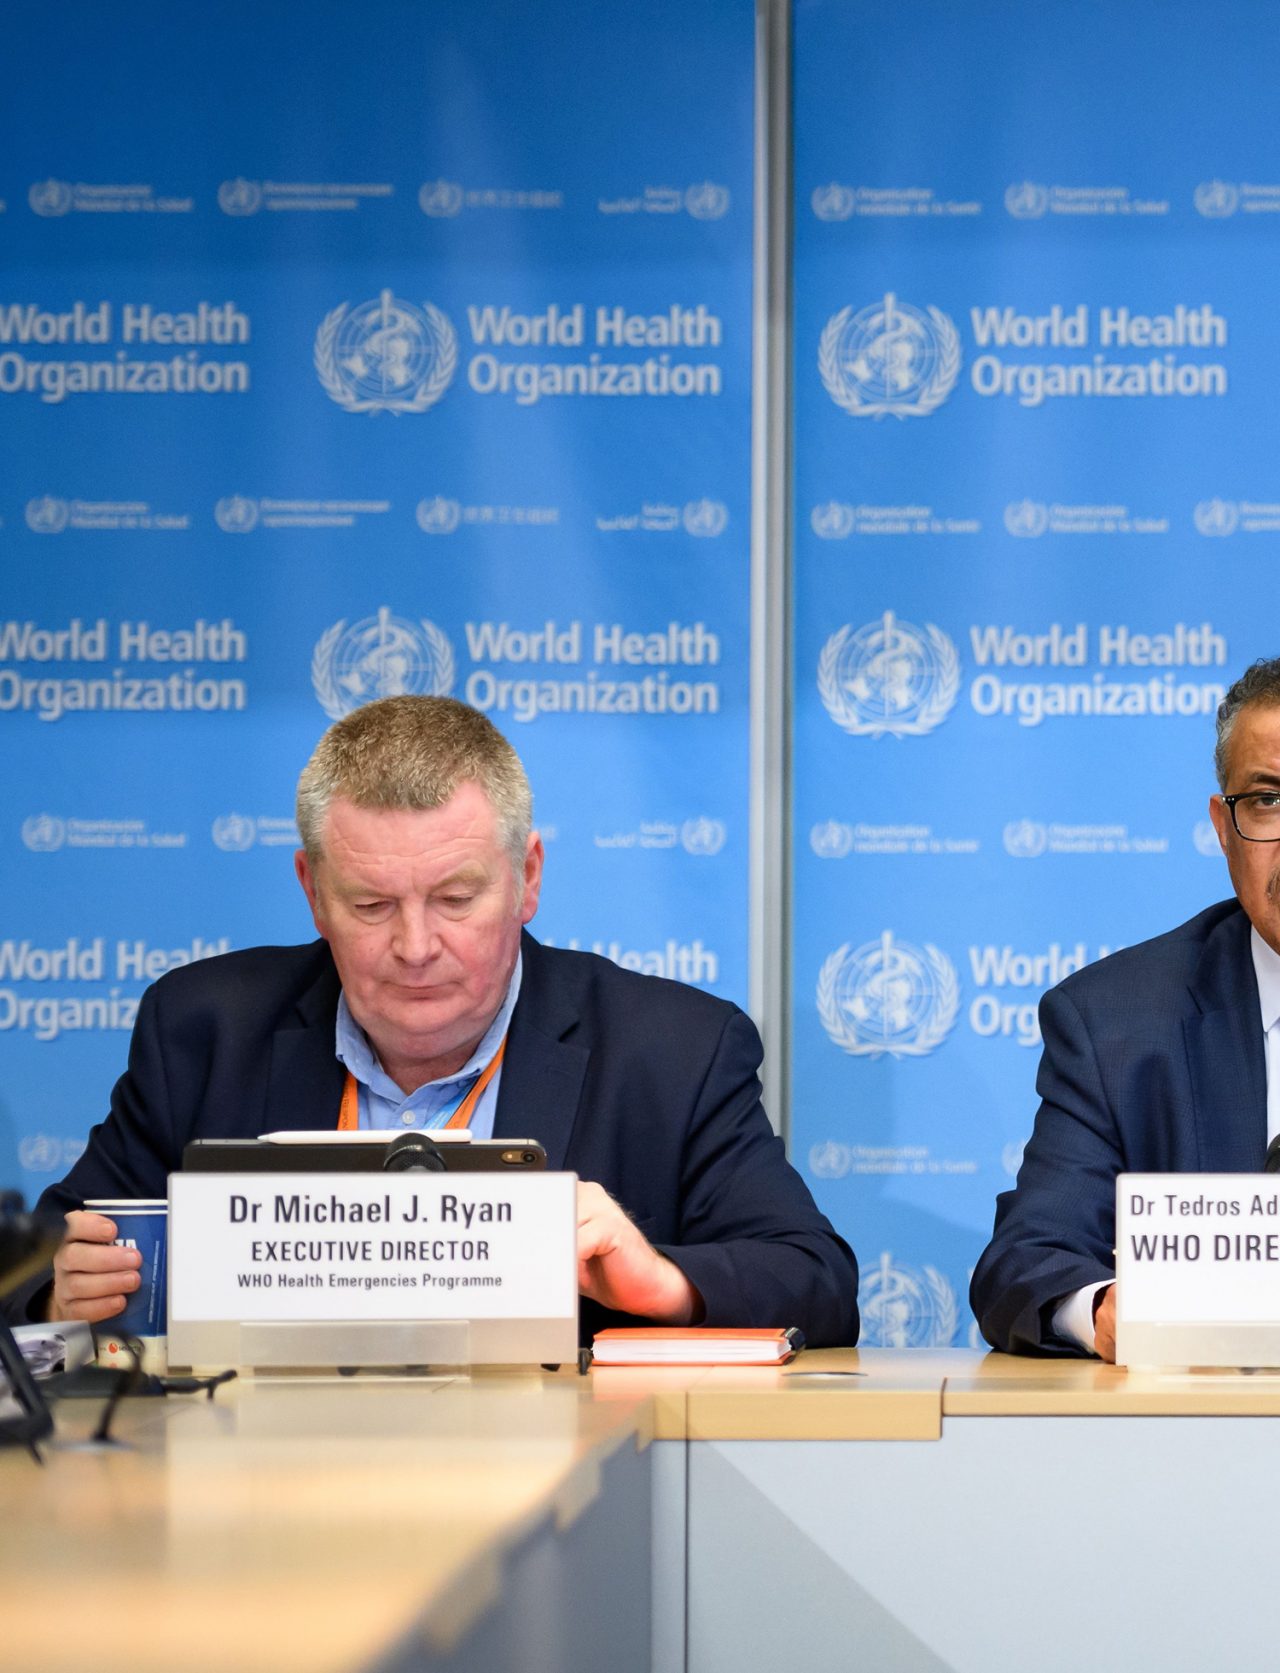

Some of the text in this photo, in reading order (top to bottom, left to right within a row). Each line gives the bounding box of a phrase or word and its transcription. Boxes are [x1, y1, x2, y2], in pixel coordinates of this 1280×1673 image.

[123, 302, 249, 344] Health
[467, 305, 721, 346] World Health
[971, 304, 1226, 347] World Health
[0, 351, 249, 403] Organization
[468, 354, 720, 406] Organization
[972, 354, 1227, 406] Organization
[120, 619, 246, 661] Health
[466, 620, 719, 664] World Health
[970, 623, 1226, 666] World Health
[0, 669, 246, 721] Organization
[466, 672, 718, 723] Organization
[971, 673, 1224, 726] Organization
[968, 943, 1088, 987] World
[229, 1194, 512, 1229] Dr Michael J. Ryan
[1131, 1194, 1154, 1216] Dr
[1165, 1194, 1240, 1215] Tedros
[252, 1240, 489, 1262] EXECUTIVE DIRECTOR
[1131, 1234, 1200, 1261] WHO
[237, 1273, 502, 1290] WHO Health Emergencies Programme
